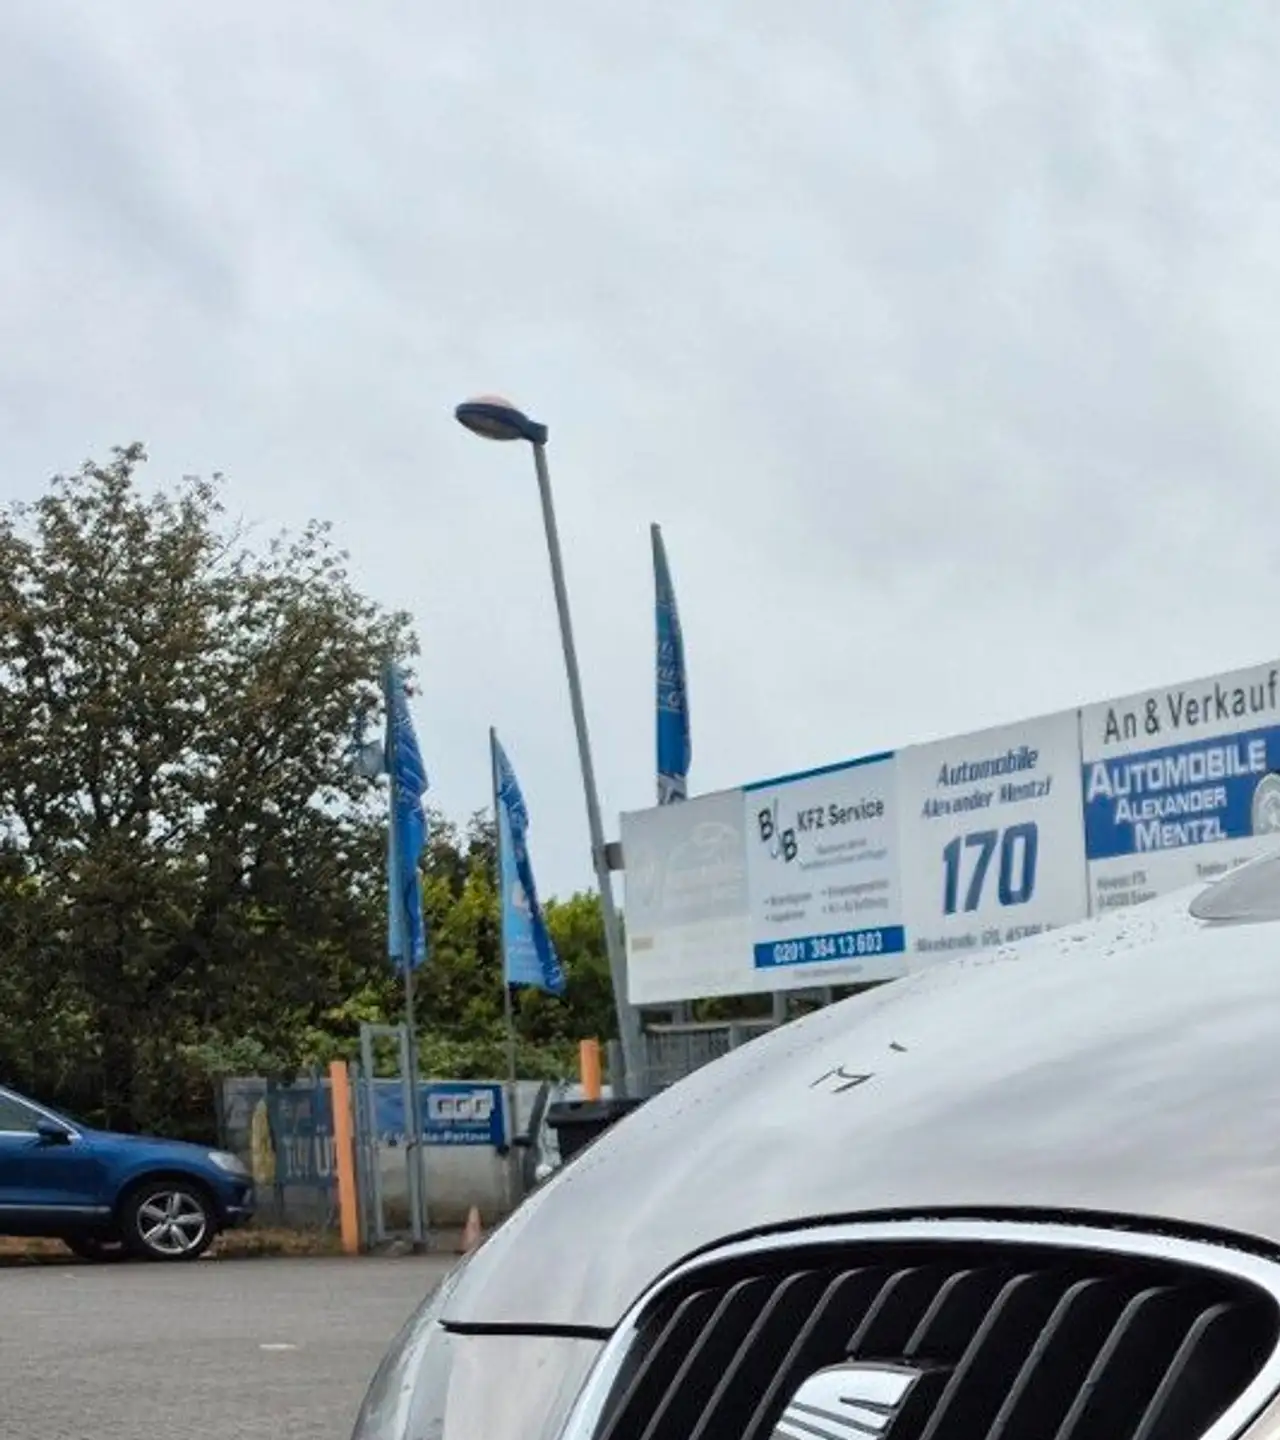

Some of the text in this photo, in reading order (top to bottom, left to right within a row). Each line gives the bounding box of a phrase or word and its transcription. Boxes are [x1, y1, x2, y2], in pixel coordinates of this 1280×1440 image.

[1103, 669, 1279, 745] An & Verkauf
[936, 745, 1040, 787] Automobile
[1087, 739, 1267, 802] AUTOMOBILE
[797, 797, 885, 832] KFZ Service
[1135, 816, 1228, 853] MENTZL
[942, 821, 1039, 916] 170
